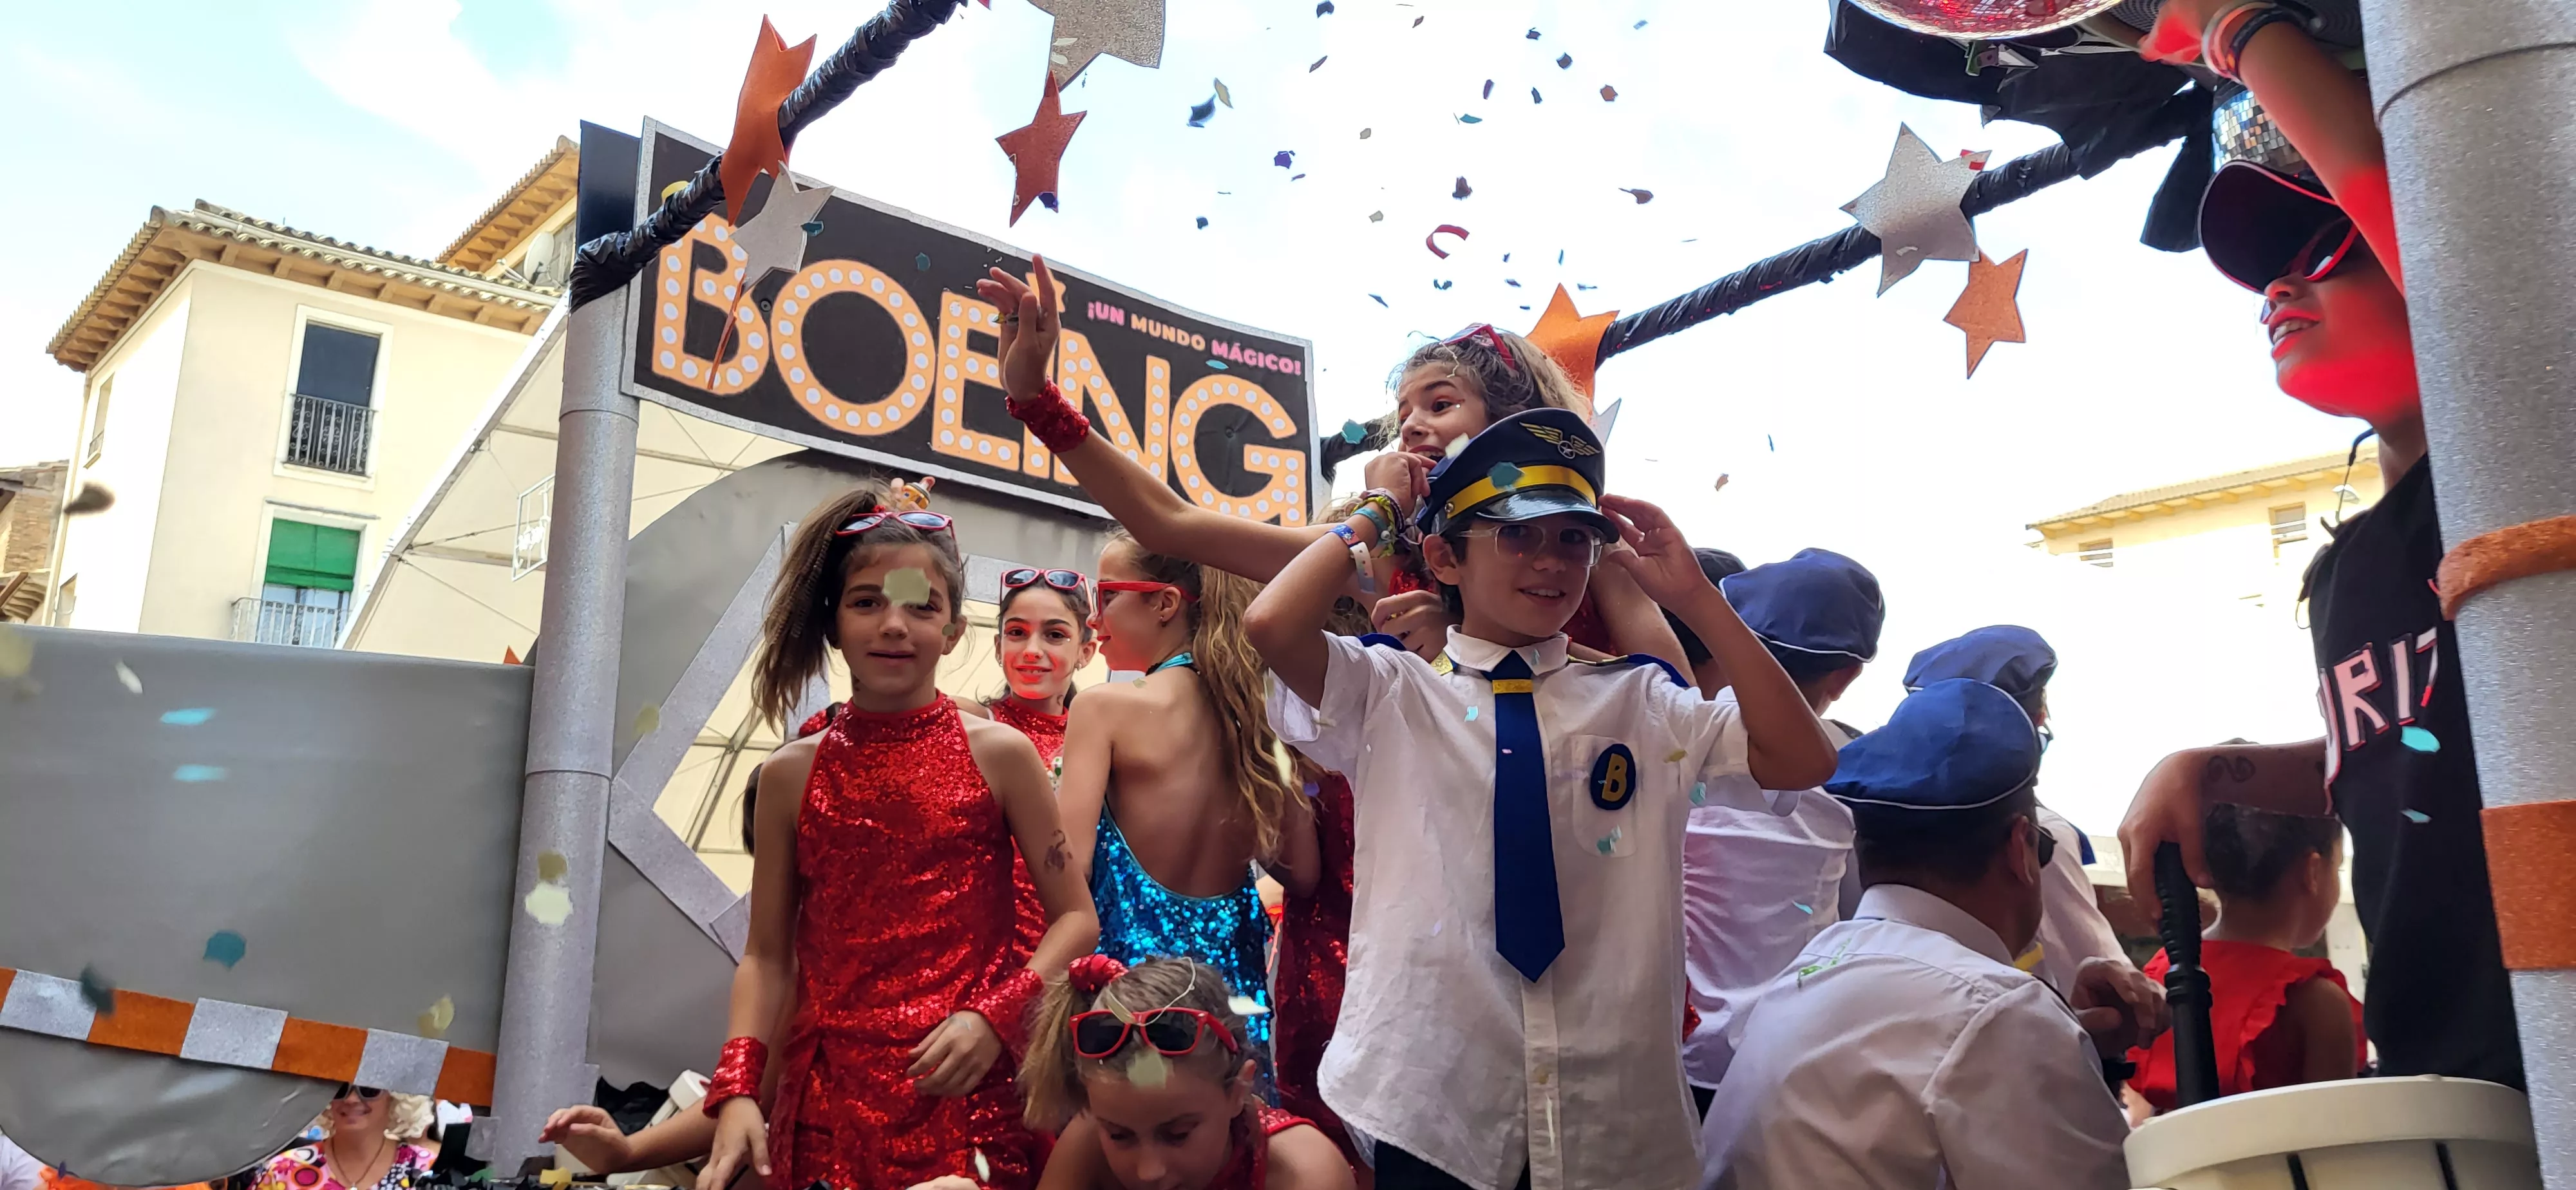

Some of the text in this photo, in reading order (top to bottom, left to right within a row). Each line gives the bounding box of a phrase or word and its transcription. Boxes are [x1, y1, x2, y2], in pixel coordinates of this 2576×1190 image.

[1088, 301, 1302, 375] ¡UN MUNDO MÁGICO!
[1602, 753, 1627, 801] B
